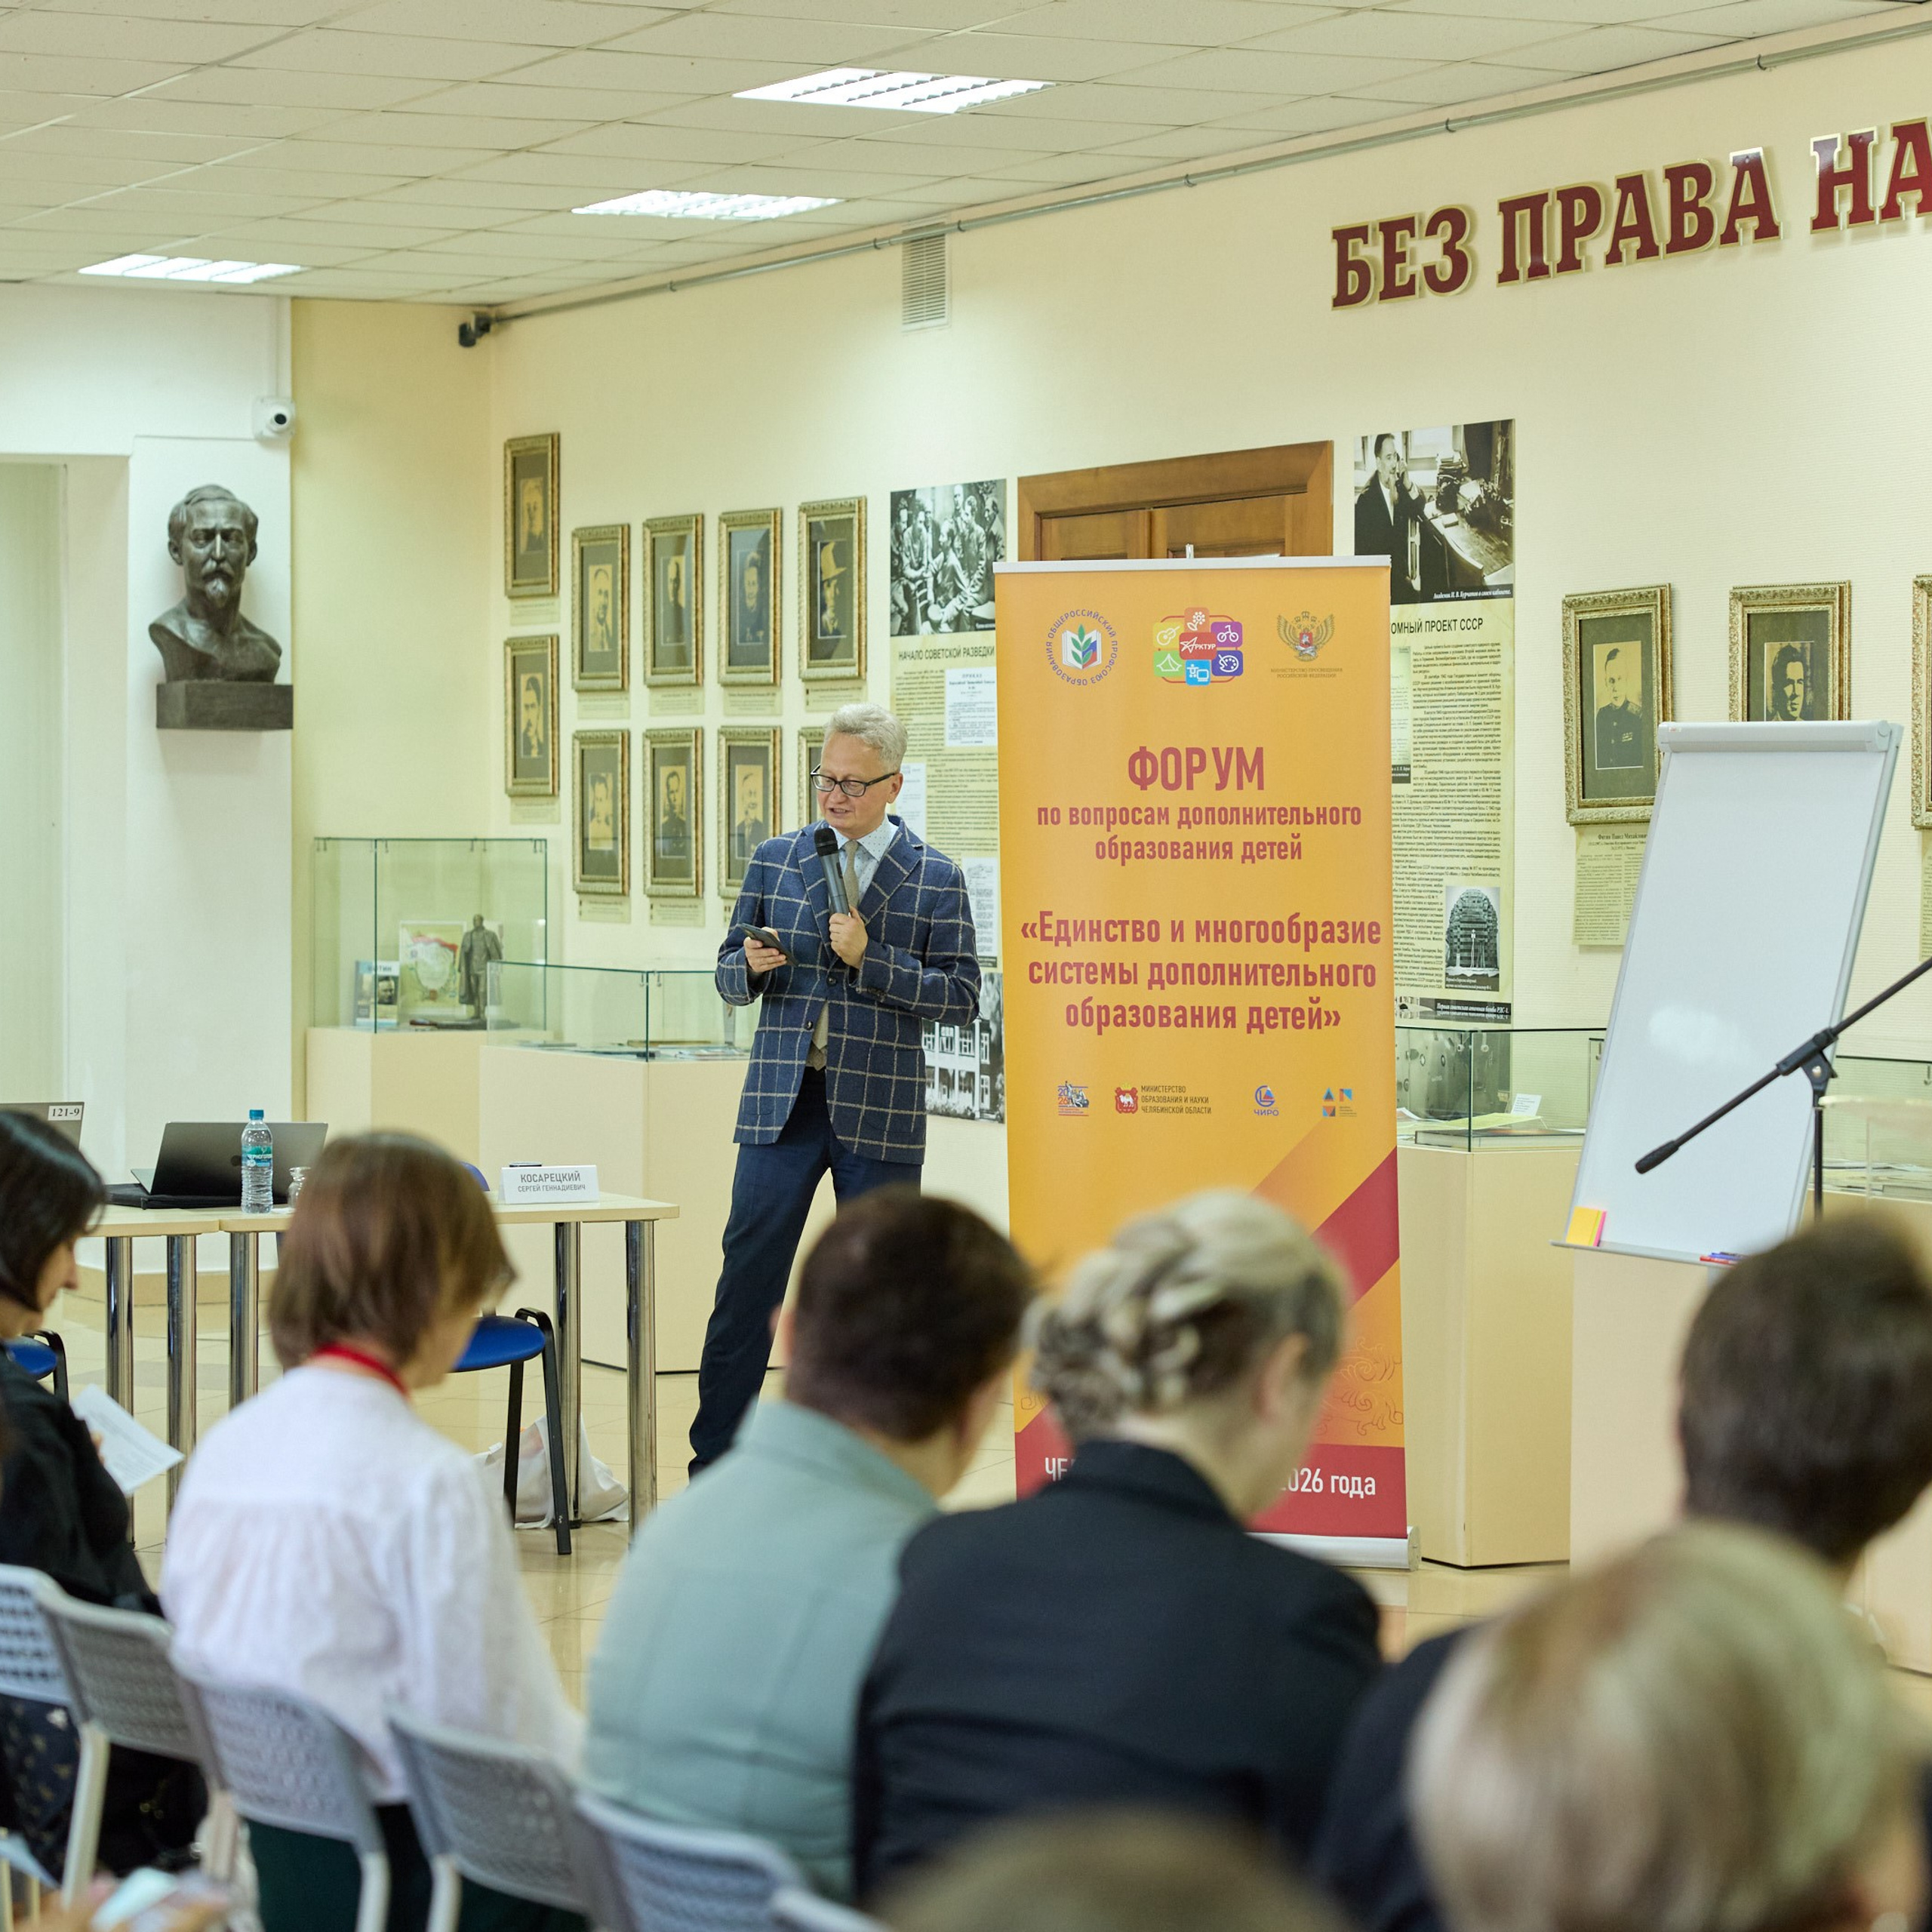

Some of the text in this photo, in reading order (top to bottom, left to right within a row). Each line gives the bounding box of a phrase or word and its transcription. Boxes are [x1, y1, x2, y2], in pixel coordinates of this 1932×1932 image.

[1332, 117, 1932, 310] БЕЗ ПРАВА НА
[1391, 617, 1484, 634] ОМНЫЙ ПРОЕКТ СССР
[898, 645, 995, 661] НАЧАЛО СОВЕТСКОЙ РАЗВЕДКИ
[1046, 609, 1118, 686] ОБЩЕРОССИЙСКИЙ ПРОФСОЮЗ ОБРАЗОВАНИЯ
[1128, 746, 1265, 792] ФОРУМ
[1037, 806, 1362, 830] по вопросам дополнительного
[1095, 832, 1302, 867] образования детей
[1020, 910, 1381, 952] «Единство и многообразие
[1029, 961, 1377, 990] системы дополнительного
[1066, 995, 1342, 1036] образования детей»
[53, 1108, 80, 1117] 121-9
[1141, 1106, 1212, 1114] ЧЕЛЯБИНСКОЙ ОБЛАСТИ
[518, 1183, 586, 1192] СЕРГЕЙ ГЕННАДИЕВИЧ
[520, 1171, 581, 1183] КОСАРЕЦКИЙ
[1281, 1467, 1324, 1494] 026
[1331, 1475, 1376, 1500] года
